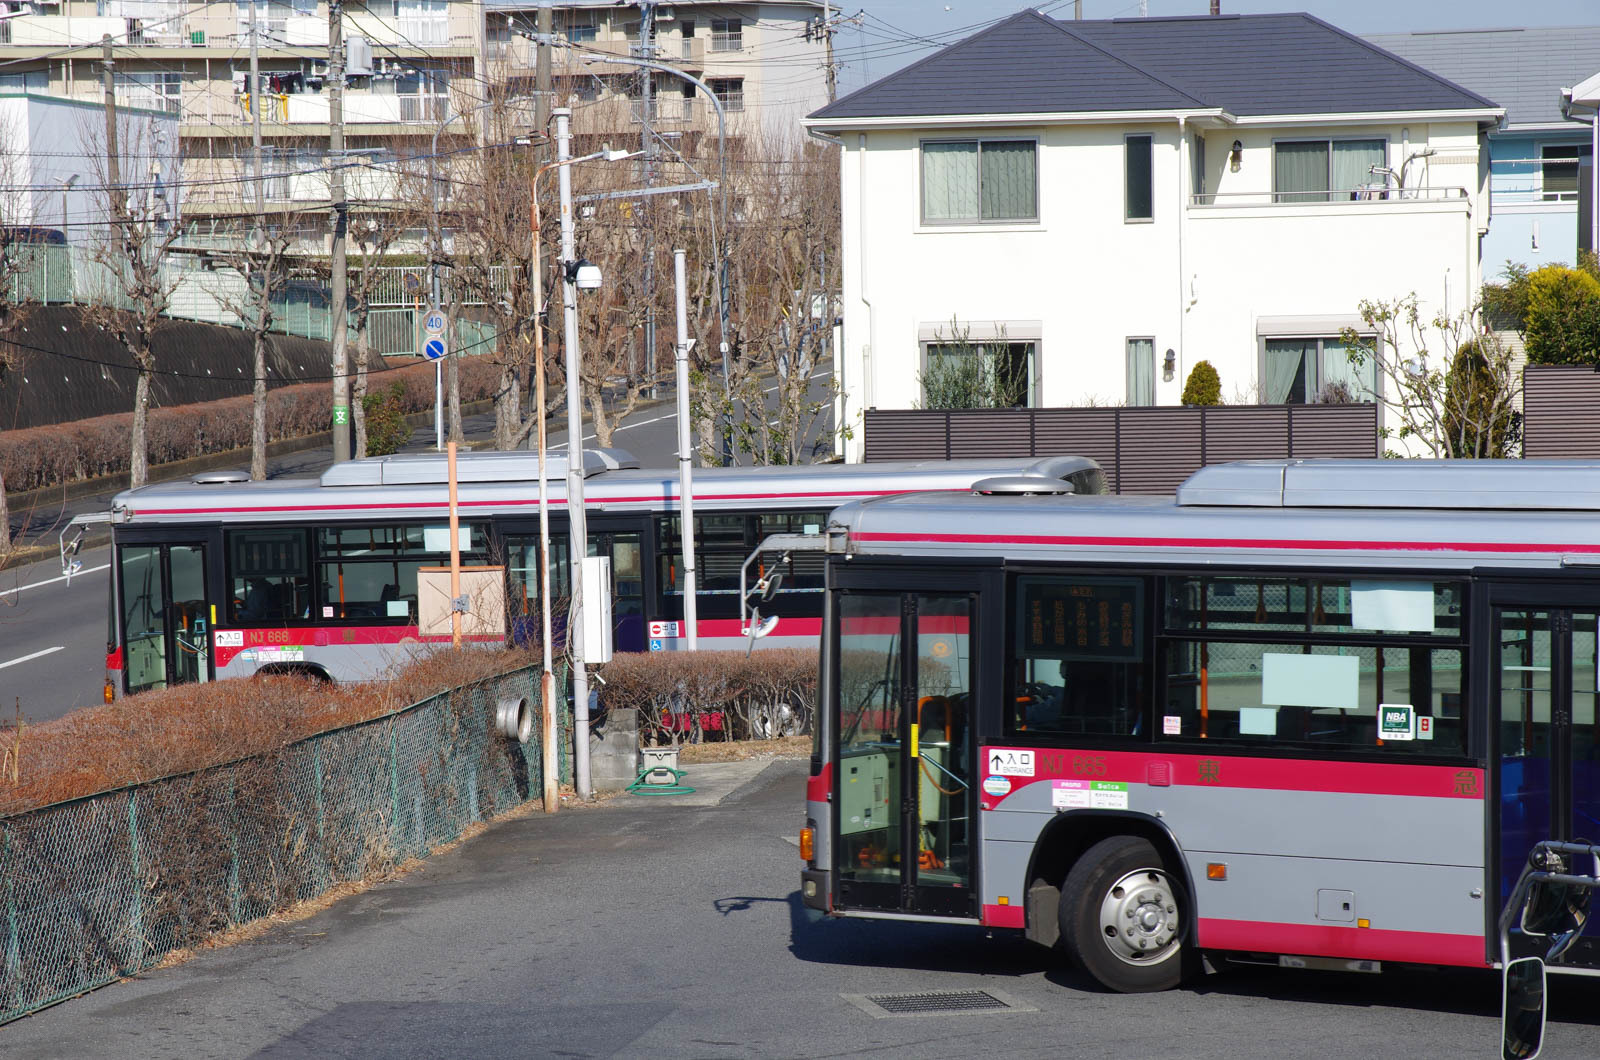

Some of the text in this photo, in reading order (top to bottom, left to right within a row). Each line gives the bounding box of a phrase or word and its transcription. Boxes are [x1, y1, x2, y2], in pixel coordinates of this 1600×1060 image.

[427, 317, 442, 328] 40
[226, 632, 241, 640] 入口
[250, 632, 264, 643] NJ
[1386, 712, 1406, 722] NBA
[1007, 753, 1030, 765] 入口
[1003, 766, 1034, 774] ENTRANCE
[1043, 754, 1107, 776] NJ 665
[1197, 759, 1221, 783] 東
[1454, 770, 1478, 795] 急
